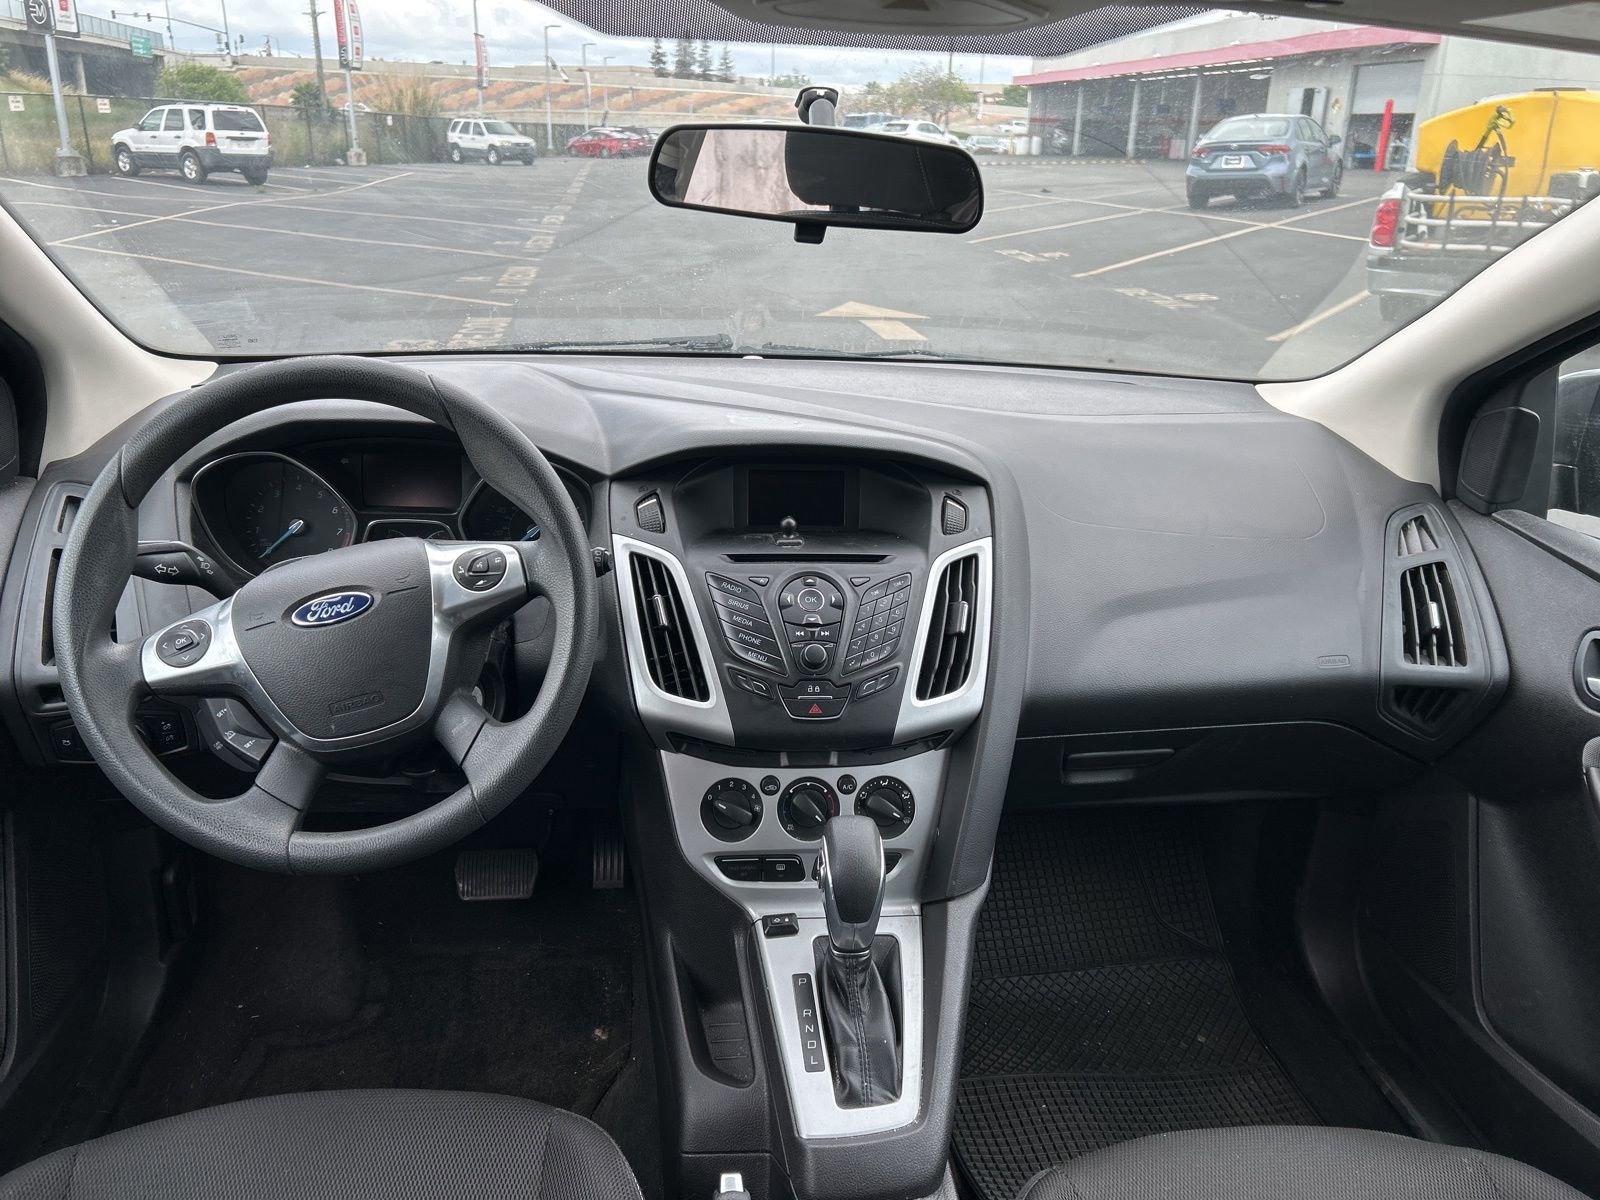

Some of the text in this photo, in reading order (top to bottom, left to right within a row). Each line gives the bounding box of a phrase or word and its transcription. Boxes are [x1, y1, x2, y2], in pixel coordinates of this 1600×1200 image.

[721, 581, 742, 593] RADIO
[306, 596, 354, 621] Ford
[727, 599, 749, 610] SIRIUS
[733, 615, 753, 626] MEDIA
[176, 636, 186, 644] OK
[739, 632, 762, 645] PHONE
[748, 651, 768, 662] MENU
[798, 978, 806, 986] P
[808, 1040, 816, 1048] D
[810, 1056, 818, 1064] L
